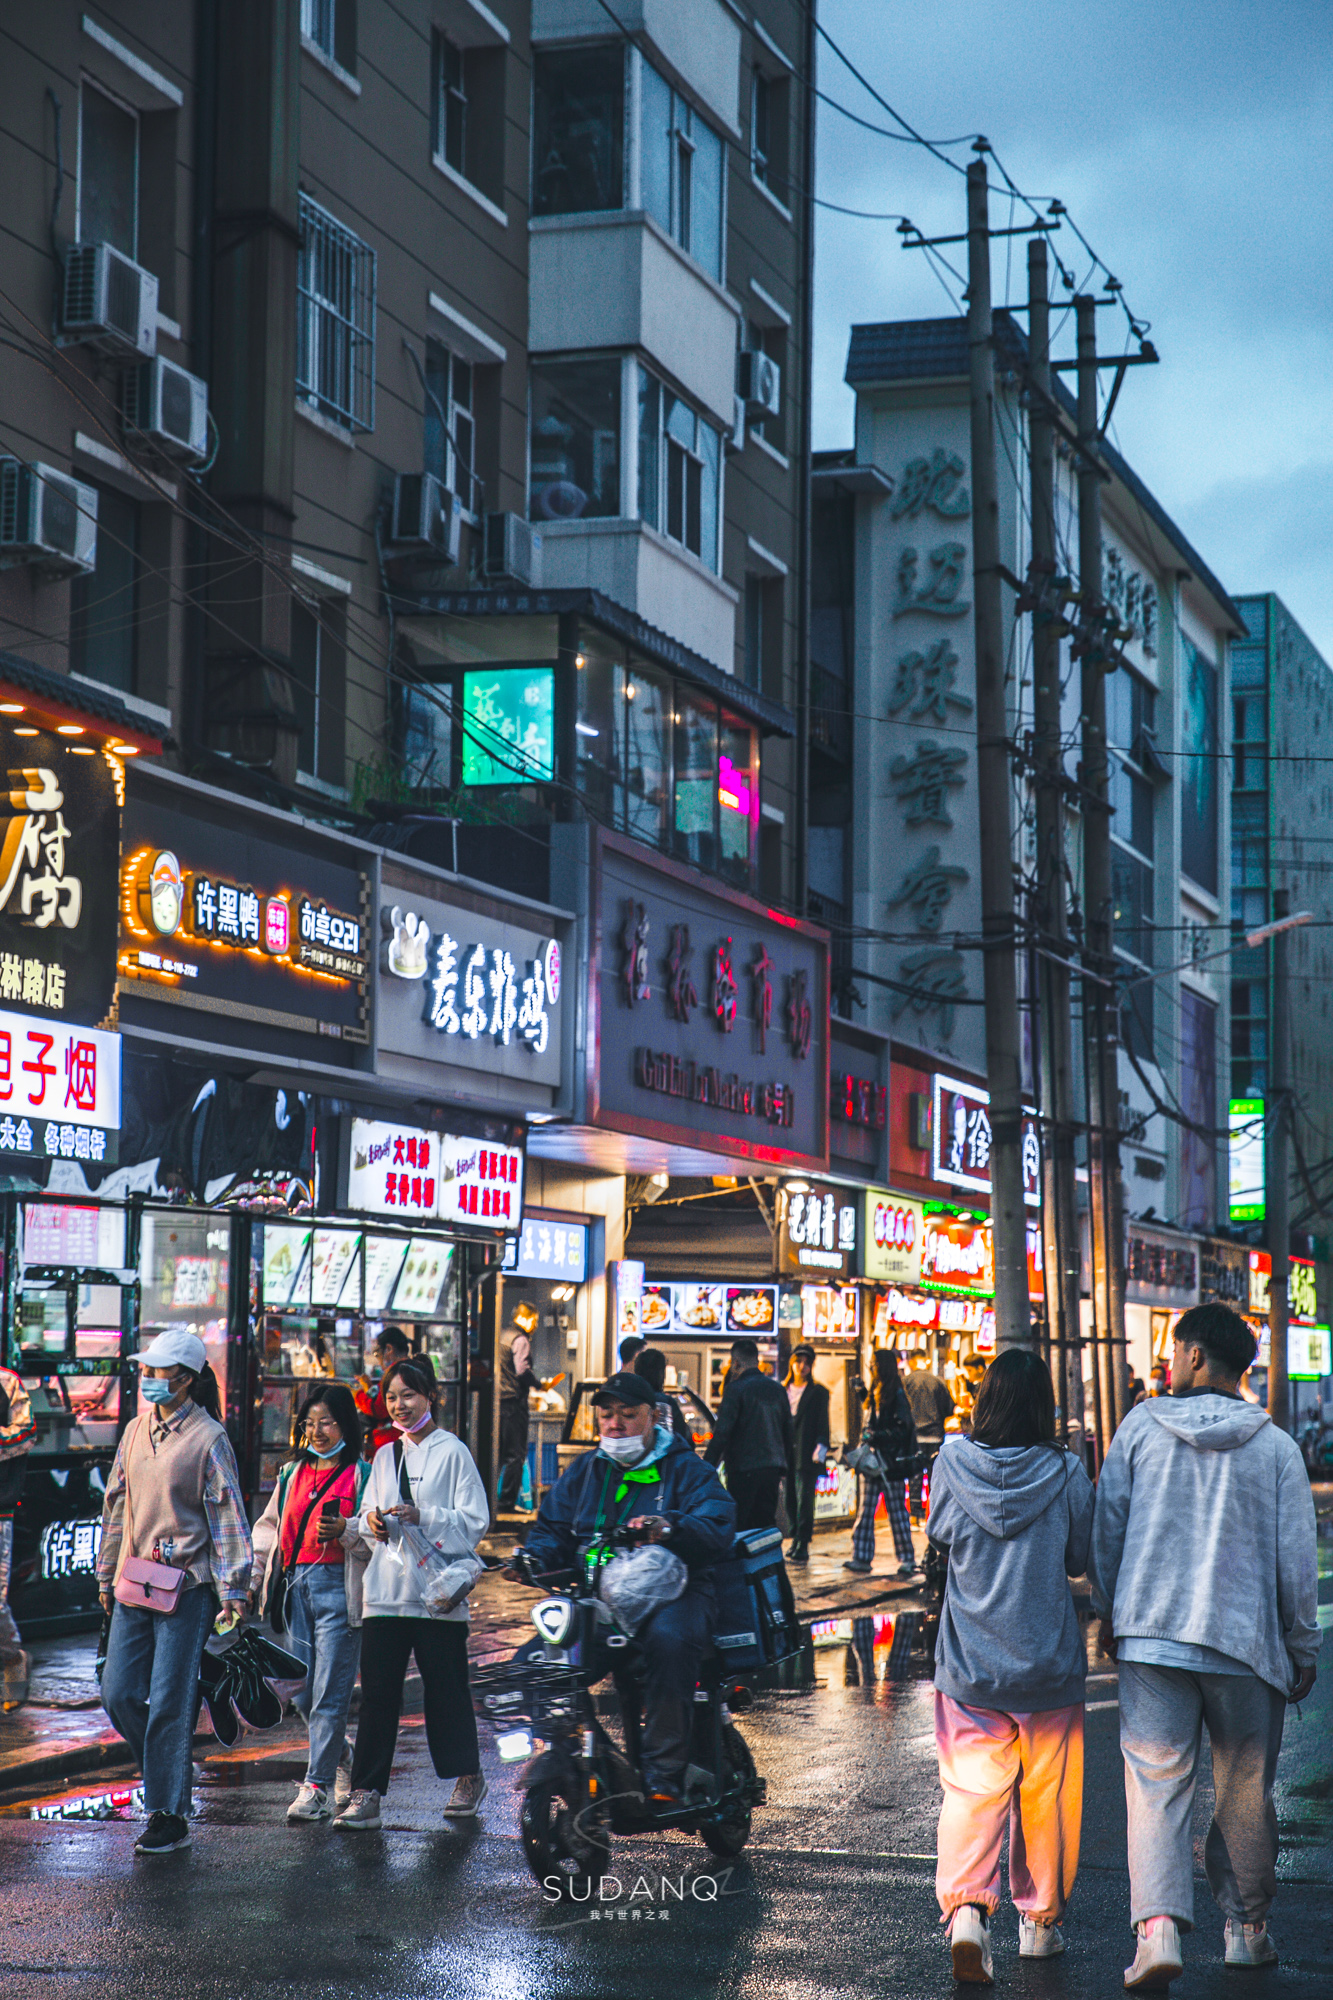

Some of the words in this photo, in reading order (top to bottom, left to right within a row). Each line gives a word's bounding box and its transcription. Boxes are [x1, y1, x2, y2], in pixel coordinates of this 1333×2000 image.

[196, 881, 260, 941] 许黑鸭
[301, 901, 359, 953] 허흑오리
[0, 953, 67, 1009] 林路店
[50, 1524, 102, 1574] 许黑
